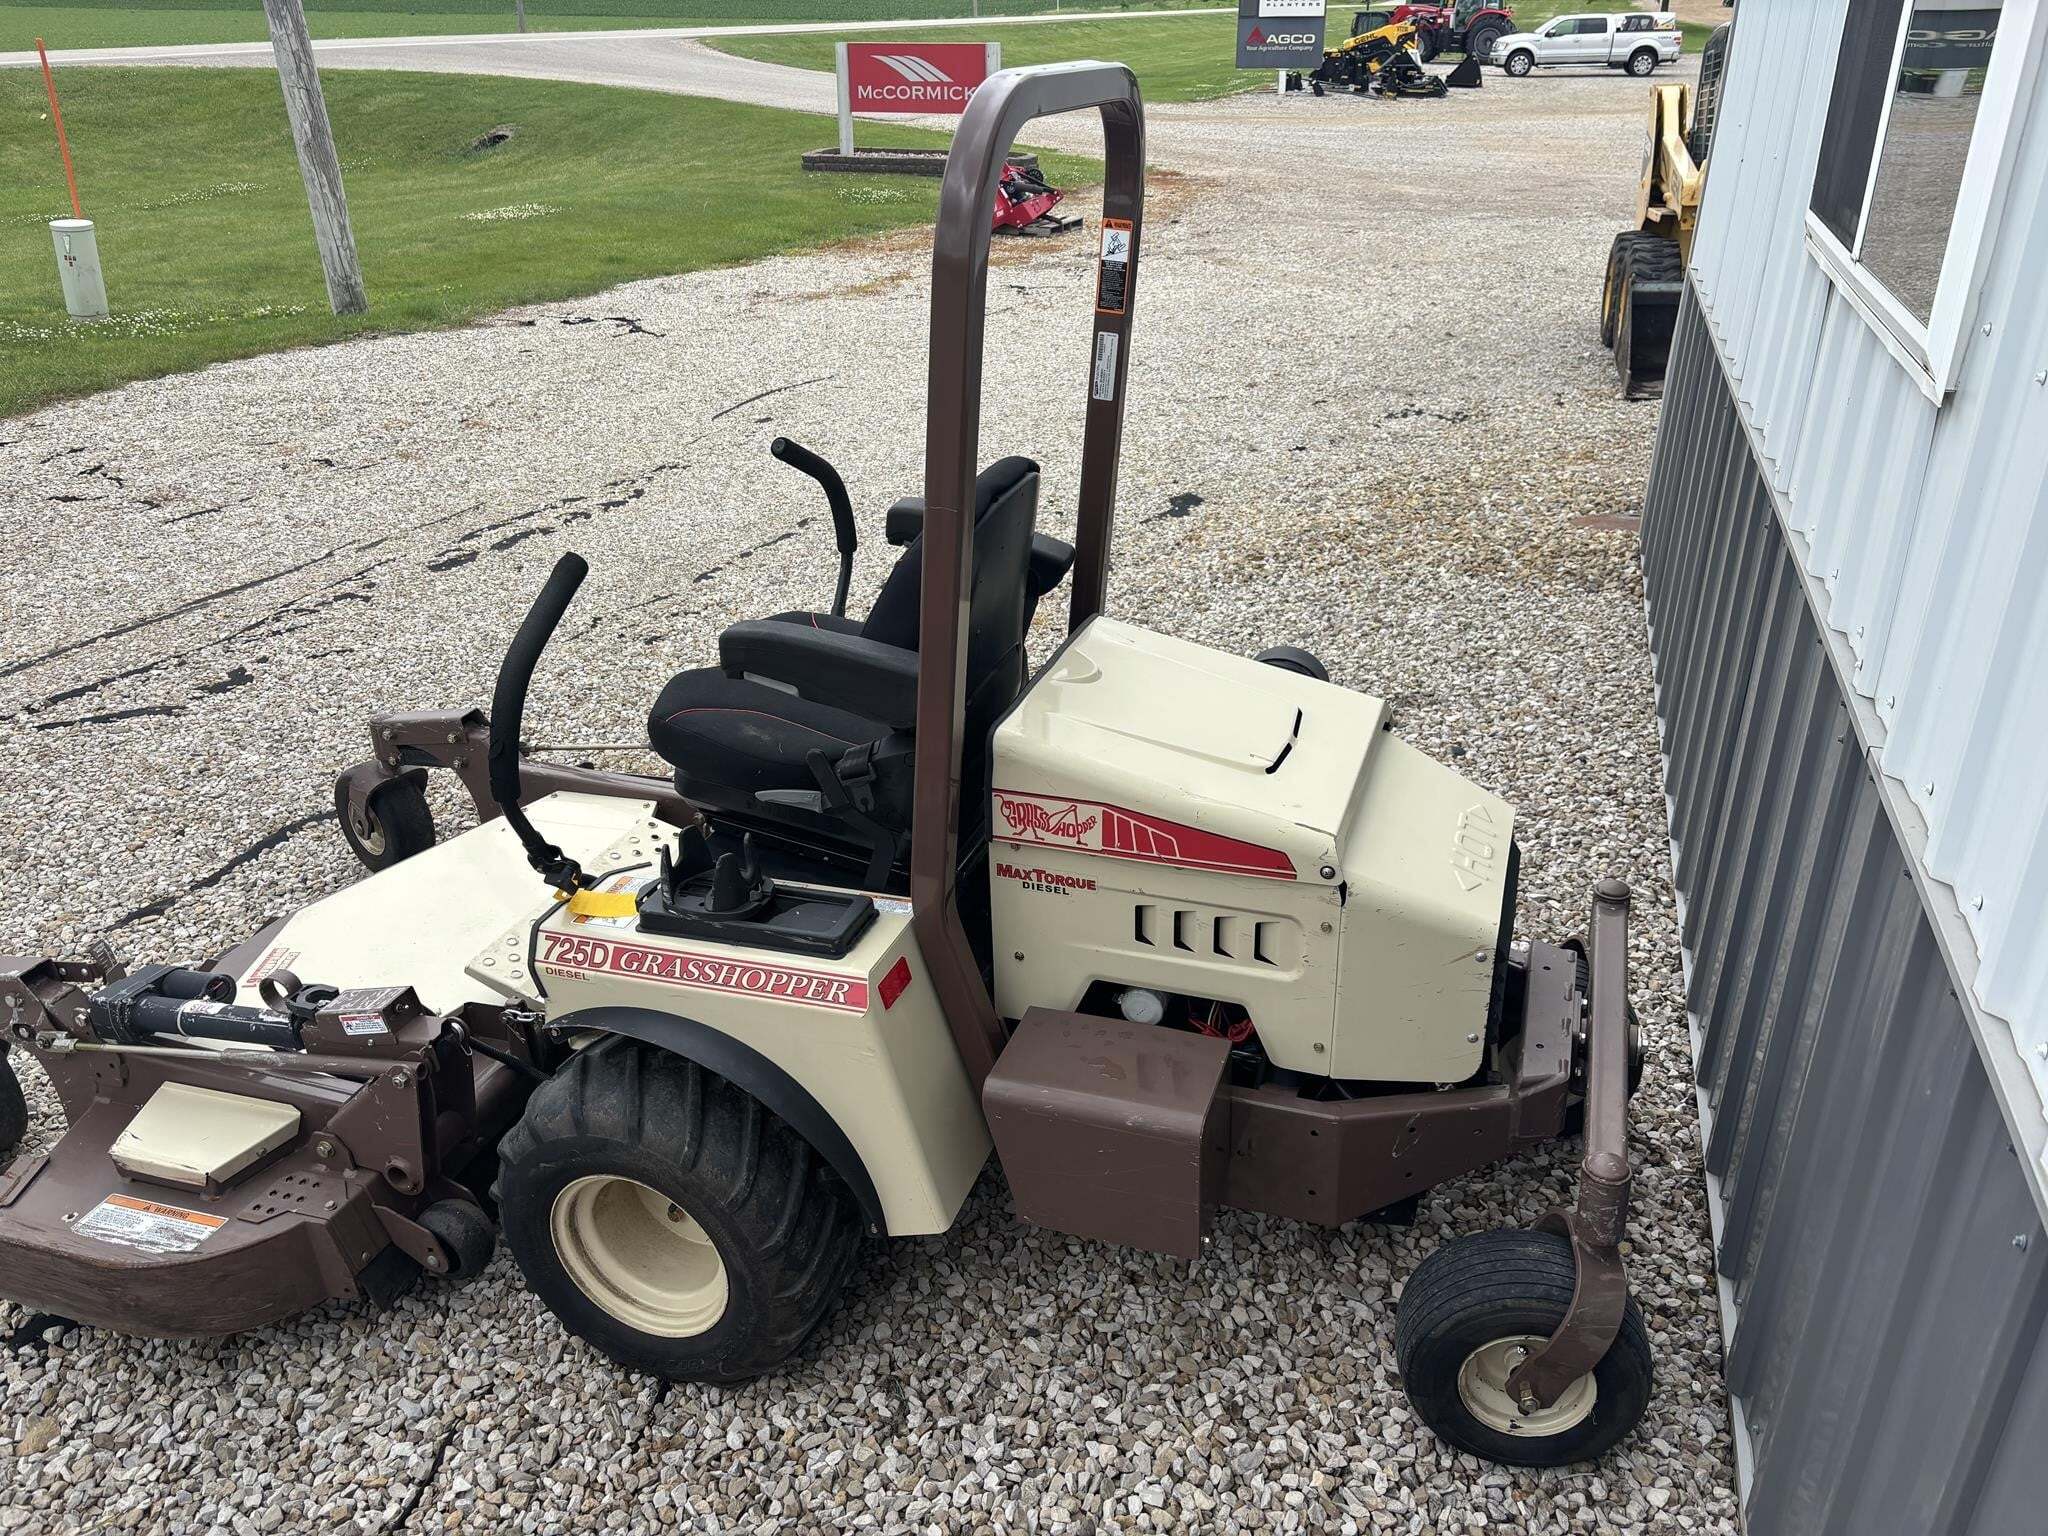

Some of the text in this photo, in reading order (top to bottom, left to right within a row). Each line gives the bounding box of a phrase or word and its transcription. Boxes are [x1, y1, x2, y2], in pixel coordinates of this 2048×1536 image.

[1266, 34, 1316, 44] AGCO
[1450, 810, 1497, 882] HOT
[1022, 881, 1071, 895] DIESEL
[543, 935, 850, 1004] 725D GRASSHOPPER
[545, 966, 590, 981] DIESEL
[154, 1205, 190, 1219] WARNING
